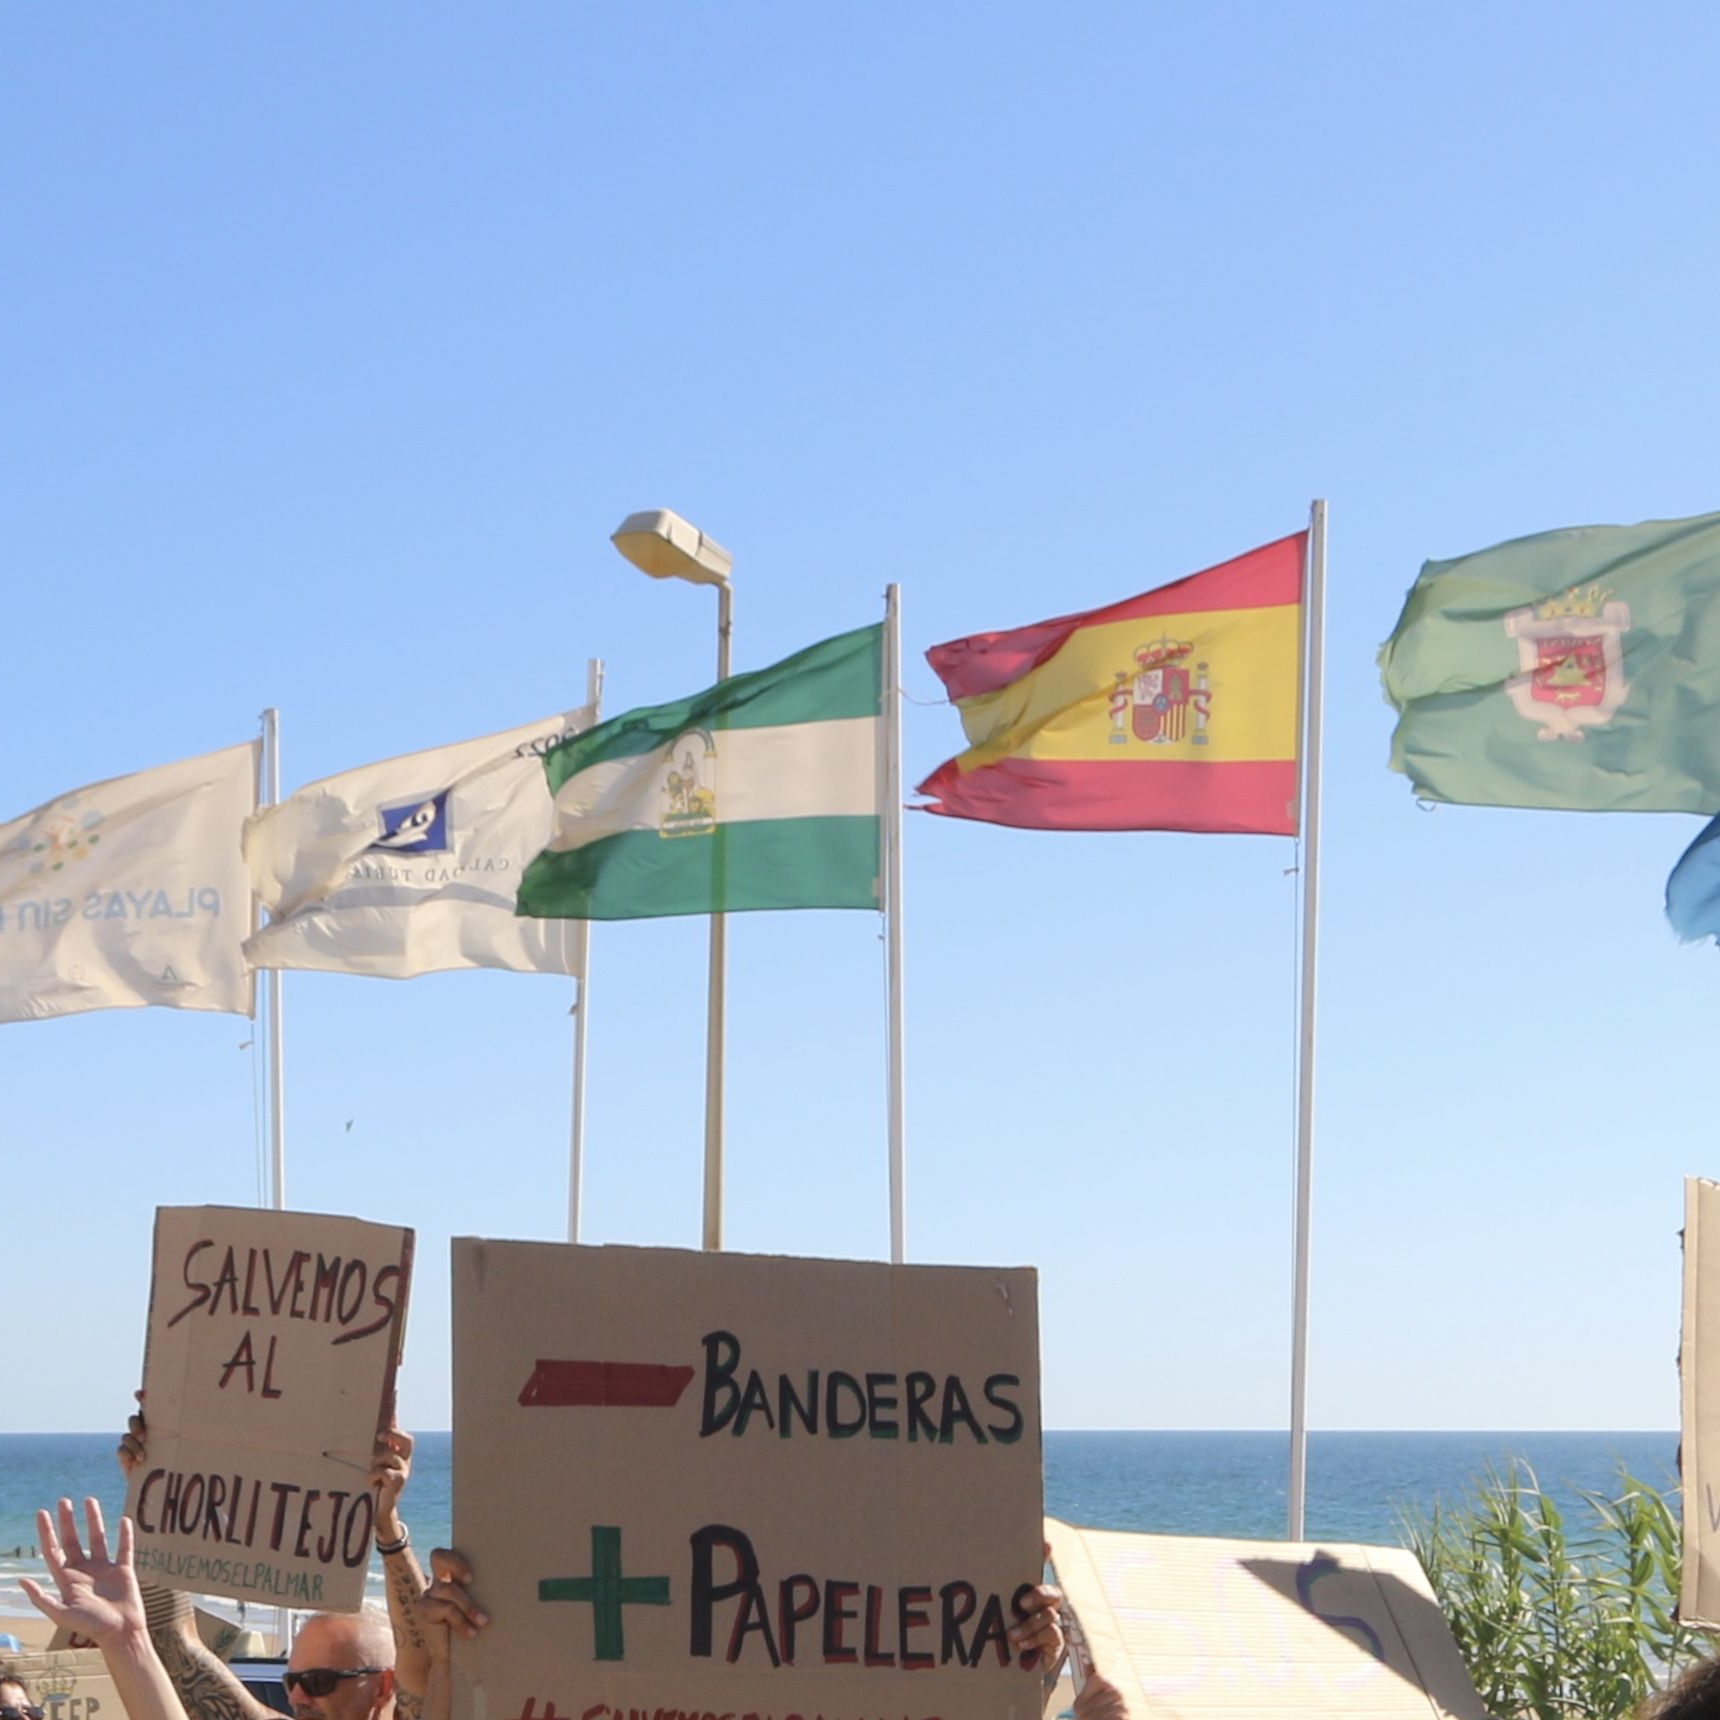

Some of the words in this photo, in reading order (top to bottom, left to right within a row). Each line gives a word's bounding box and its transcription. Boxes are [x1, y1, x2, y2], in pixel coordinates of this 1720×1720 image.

[167, 1239, 402, 1346] SALVEMOS
[218, 1330, 282, 1399] AL
[136, 1468, 374, 1568] CHORLITEJO
[135, 1547, 324, 1602] #SALVEMOSELPALMAR
